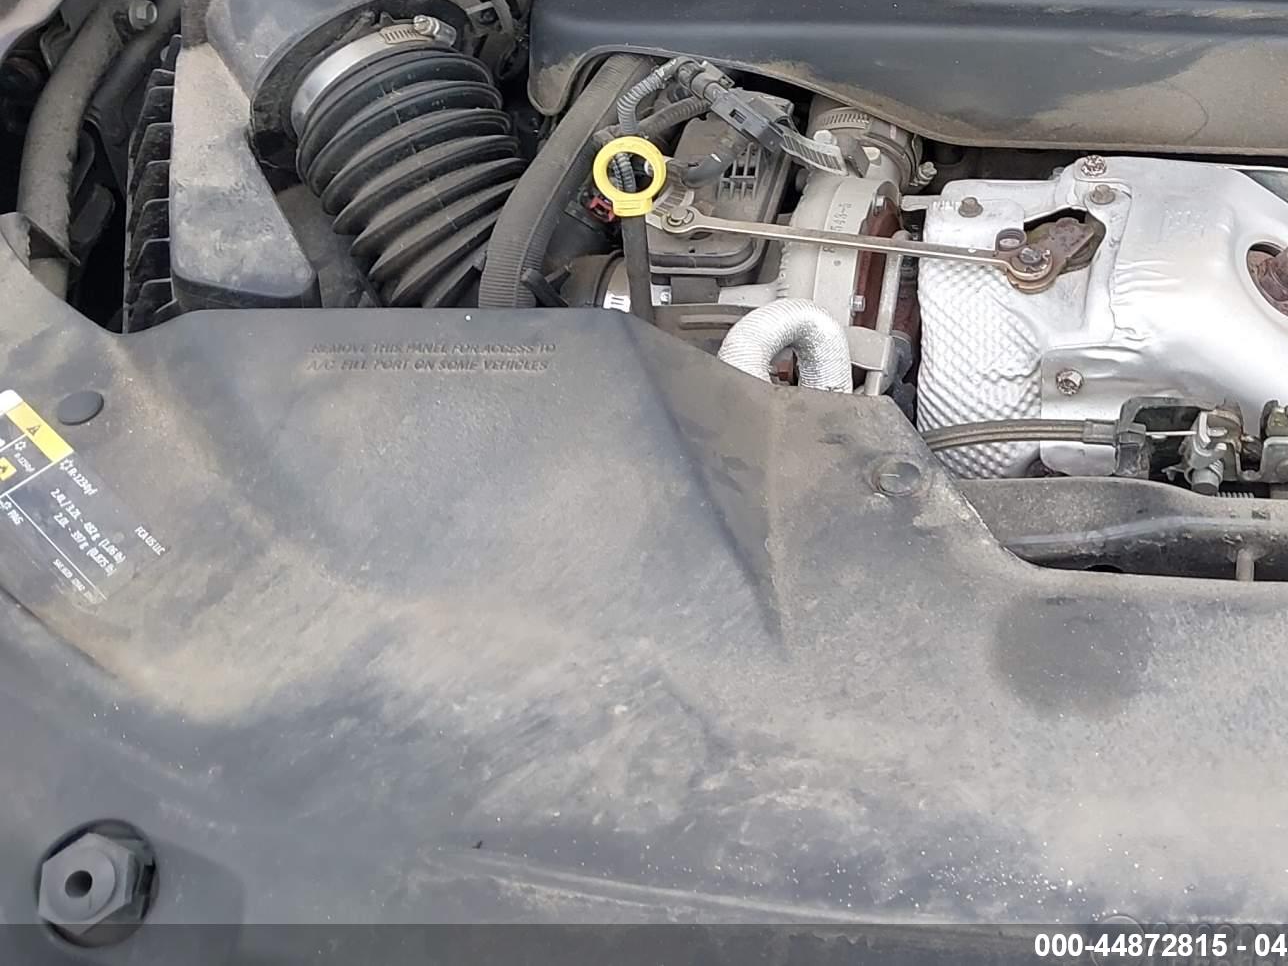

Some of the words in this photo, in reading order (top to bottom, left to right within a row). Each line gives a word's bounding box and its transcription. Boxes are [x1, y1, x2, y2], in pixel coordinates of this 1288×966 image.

[311, 343, 368, 355] REMOVE
[372, 343, 404, 355] THIS
[406, 343, 448, 355] PANEL
[451, 343, 478, 355] FOR
[478, 343, 534, 355] ACCESS
[538, 343, 557, 355] TO
[340, 358, 368, 372] FILL
[373, 358, 410, 372] PORT
[413, 358, 435, 372] ON
[438, 358, 480, 372] SOME
[483, 358, 548, 372] VEHICLES
[67, 467, 98, 496] R-1234yf
[134, 526, 149, 541] FCA
[151, 542, 166, 557] LLC
